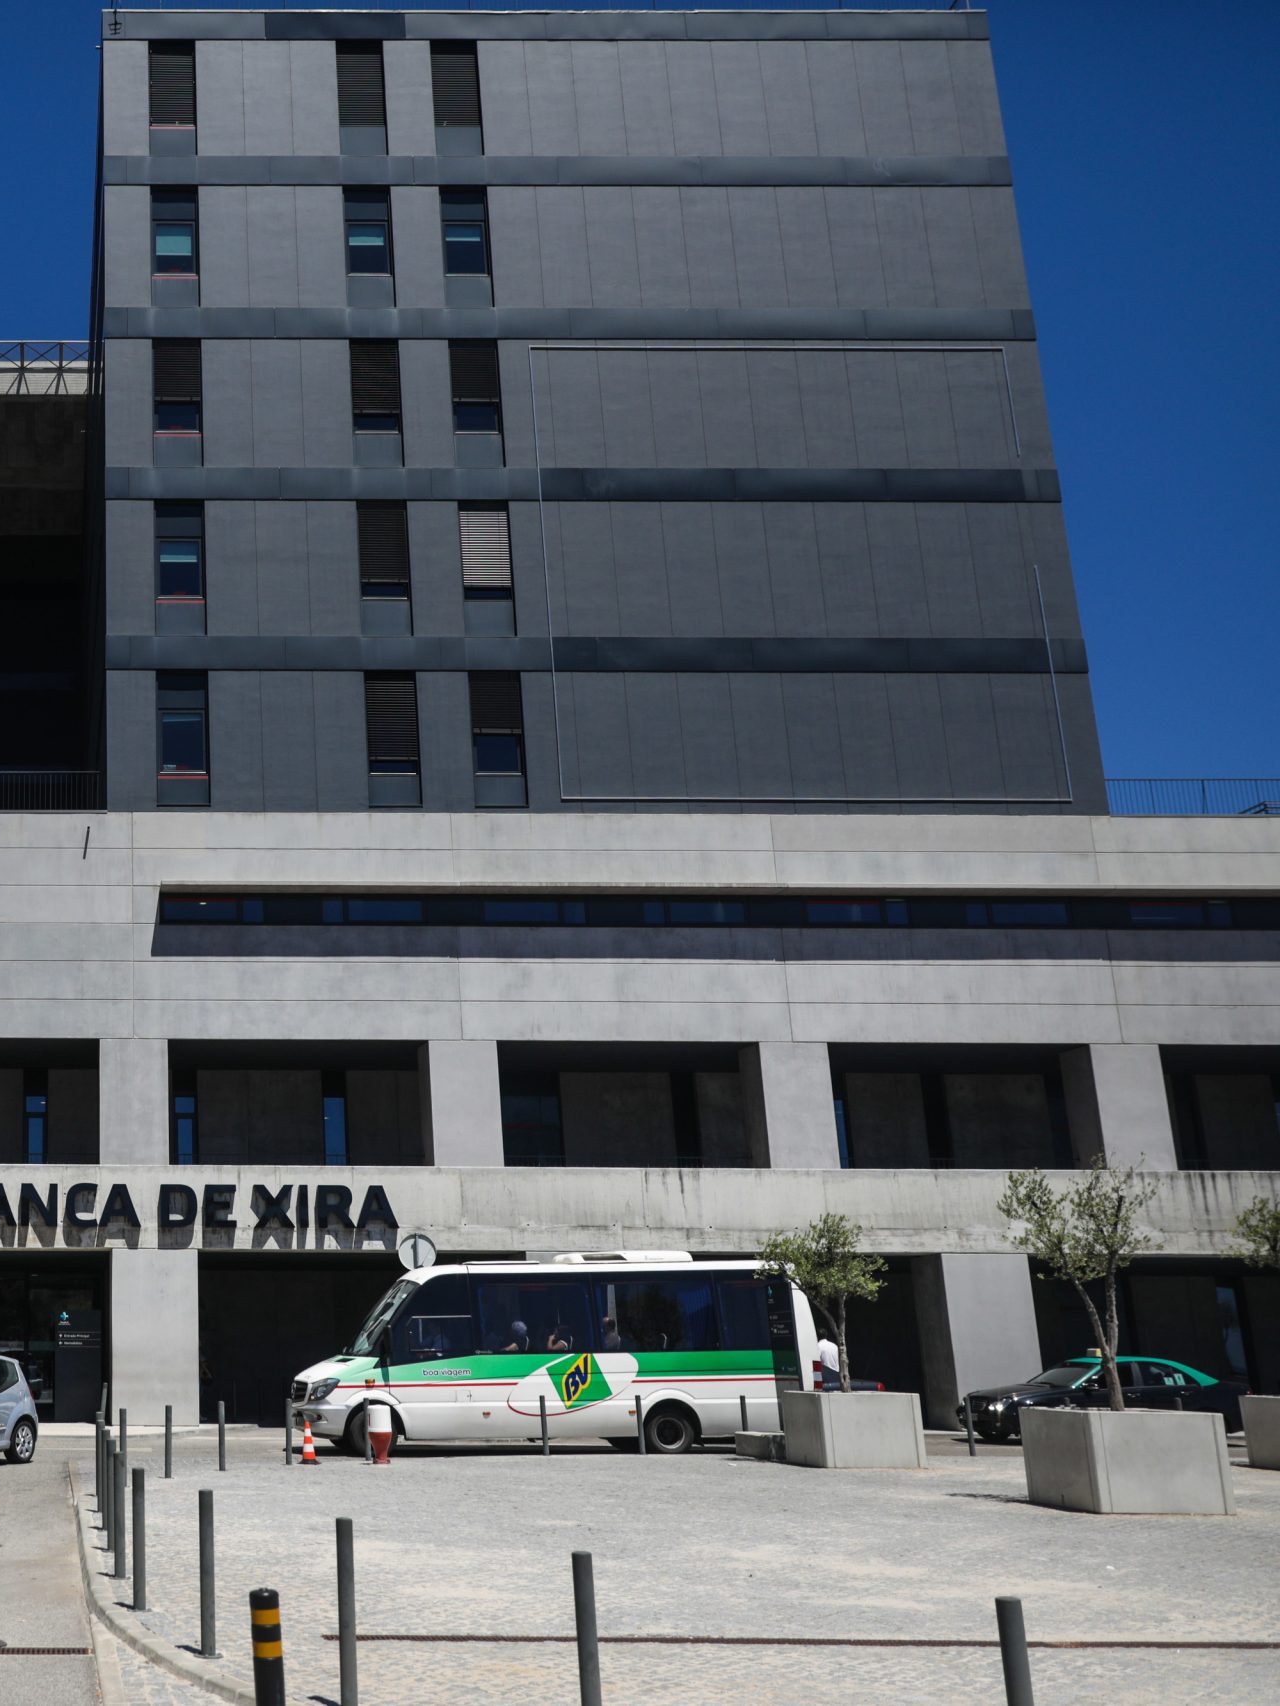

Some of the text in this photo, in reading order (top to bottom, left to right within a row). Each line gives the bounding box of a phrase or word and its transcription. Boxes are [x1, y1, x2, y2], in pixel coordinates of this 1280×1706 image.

[158, 1184, 238, 1229] DE
[251, 1184, 400, 1229] XIRA
[440, 1369, 471, 1378] viagem
[563, 1354, 590, 1403] BV
